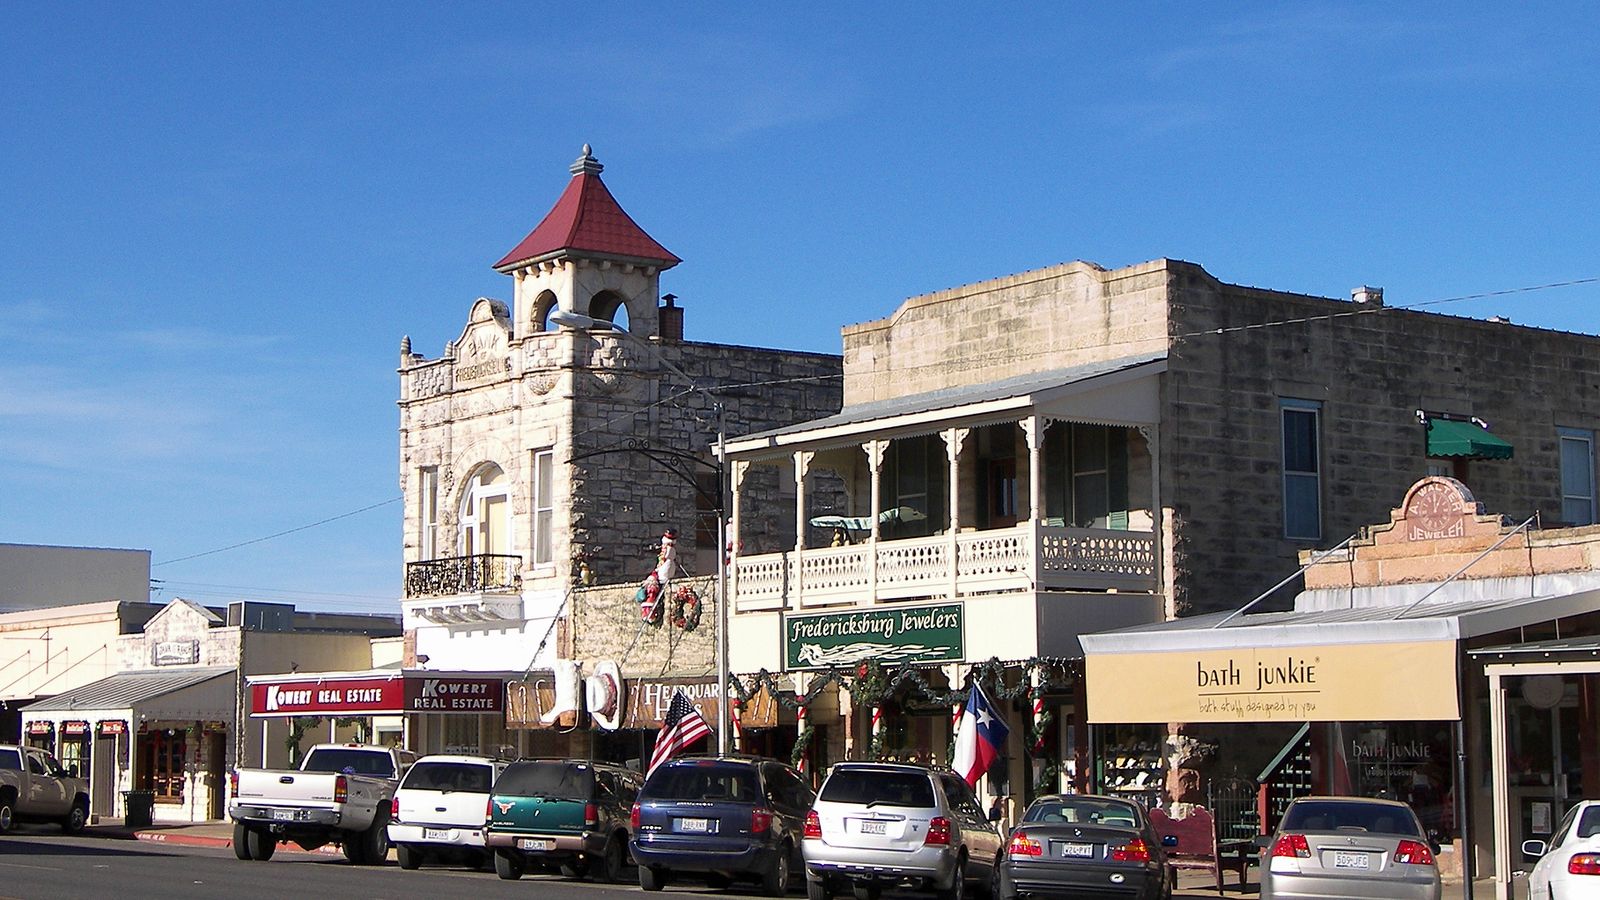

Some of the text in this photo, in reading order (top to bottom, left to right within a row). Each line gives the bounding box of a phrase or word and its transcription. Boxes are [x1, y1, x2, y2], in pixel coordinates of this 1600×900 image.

[1418, 483, 1462, 512] WALTER
[1409, 518, 1464, 541] JEWELER
[791, 607, 958, 642] Fredericksburg Jewelers
[266, 685, 382, 710] KOWERT REAL ESTATE
[424, 679, 488, 697] KOWERT
[414, 698, 494, 709] REAL ESTATE
[1220, 697, 1244, 718] stuff
[1246, 695, 1285, 718] designed
[1287, 698, 1298, 718] by
[1301, 702, 1316, 718] you
